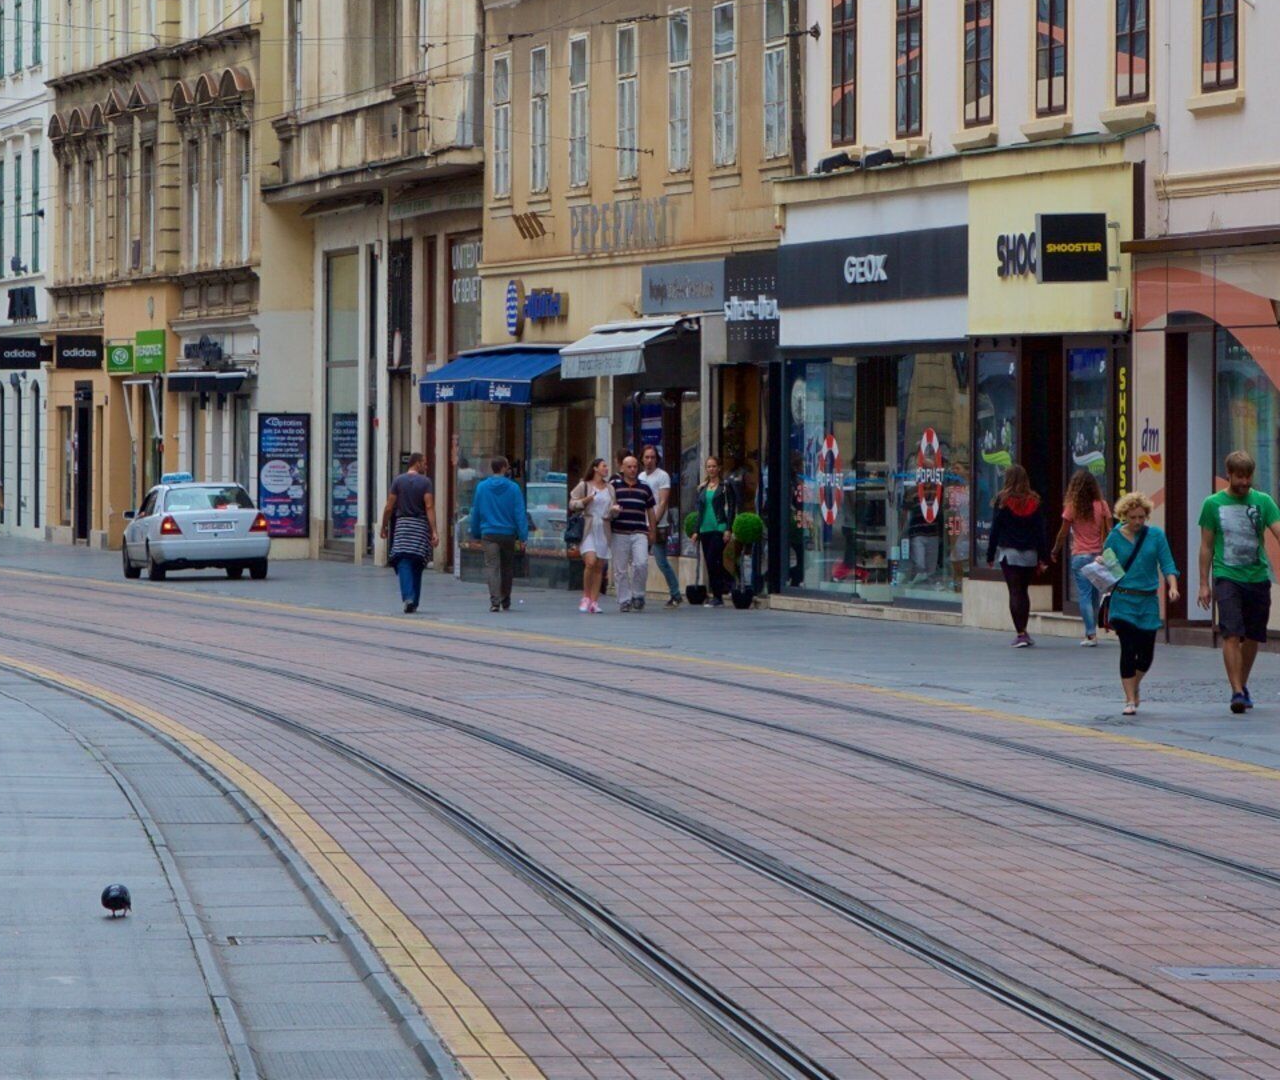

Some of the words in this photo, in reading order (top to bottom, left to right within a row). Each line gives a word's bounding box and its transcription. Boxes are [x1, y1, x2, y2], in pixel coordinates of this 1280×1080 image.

[1045, 242, 1102, 253] SHOOSTER
[844, 253, 889, 284] GEOX
[3, 348, 37, 359] adidas
[62, 347, 97, 358] adidas
[1141, 417, 1160, 453] dm
[915, 467, 945, 484] POPUST
